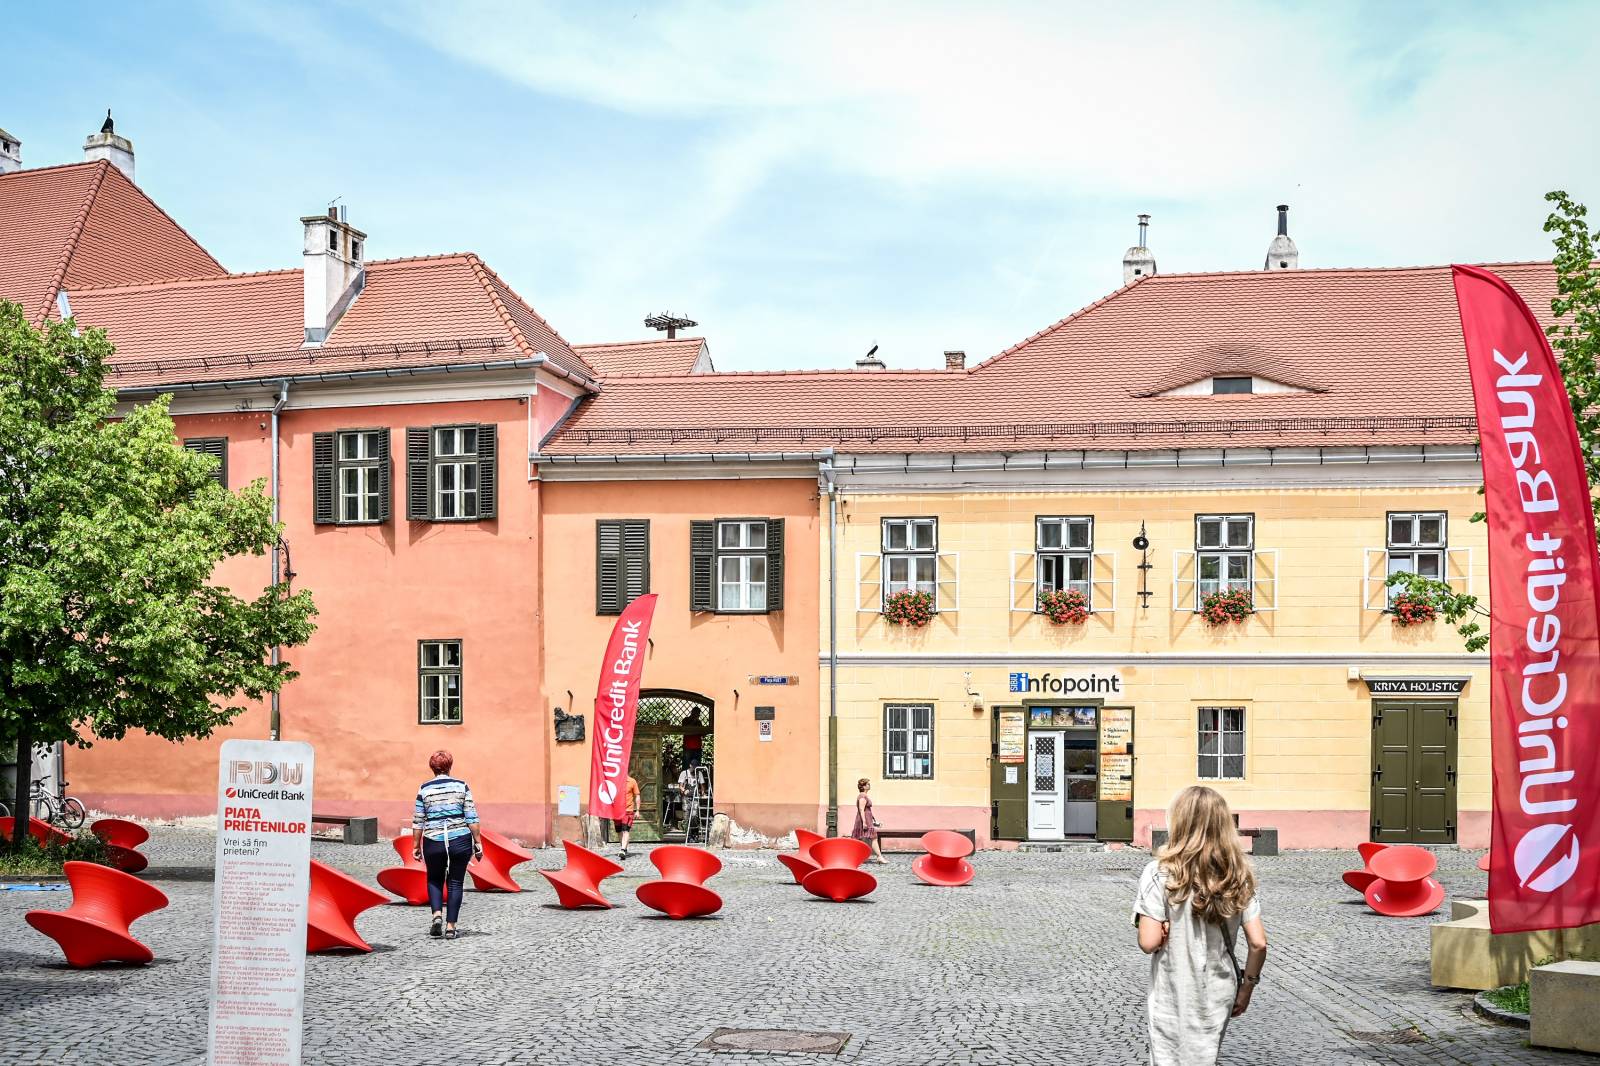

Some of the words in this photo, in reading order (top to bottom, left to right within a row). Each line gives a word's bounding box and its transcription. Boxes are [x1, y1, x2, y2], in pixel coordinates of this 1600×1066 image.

[613, 619, 642, 675] Bank
[1020, 673, 1120, 695] infopoint
[1373, 682, 1408, 691] KRIYA
[1410, 682, 1459, 691] HOLISTIC
[602, 680, 629, 778] UniCredit
[229, 760, 304, 786] RDW
[237, 788, 279, 800] UniCredit
[281, 790, 305, 801] Bank
[224, 820, 306, 834] PRIETENILOR
[223, 838, 240, 847] Vrei
[253, 838, 268, 847] fim
[223, 847, 260, 856] prieteni?
